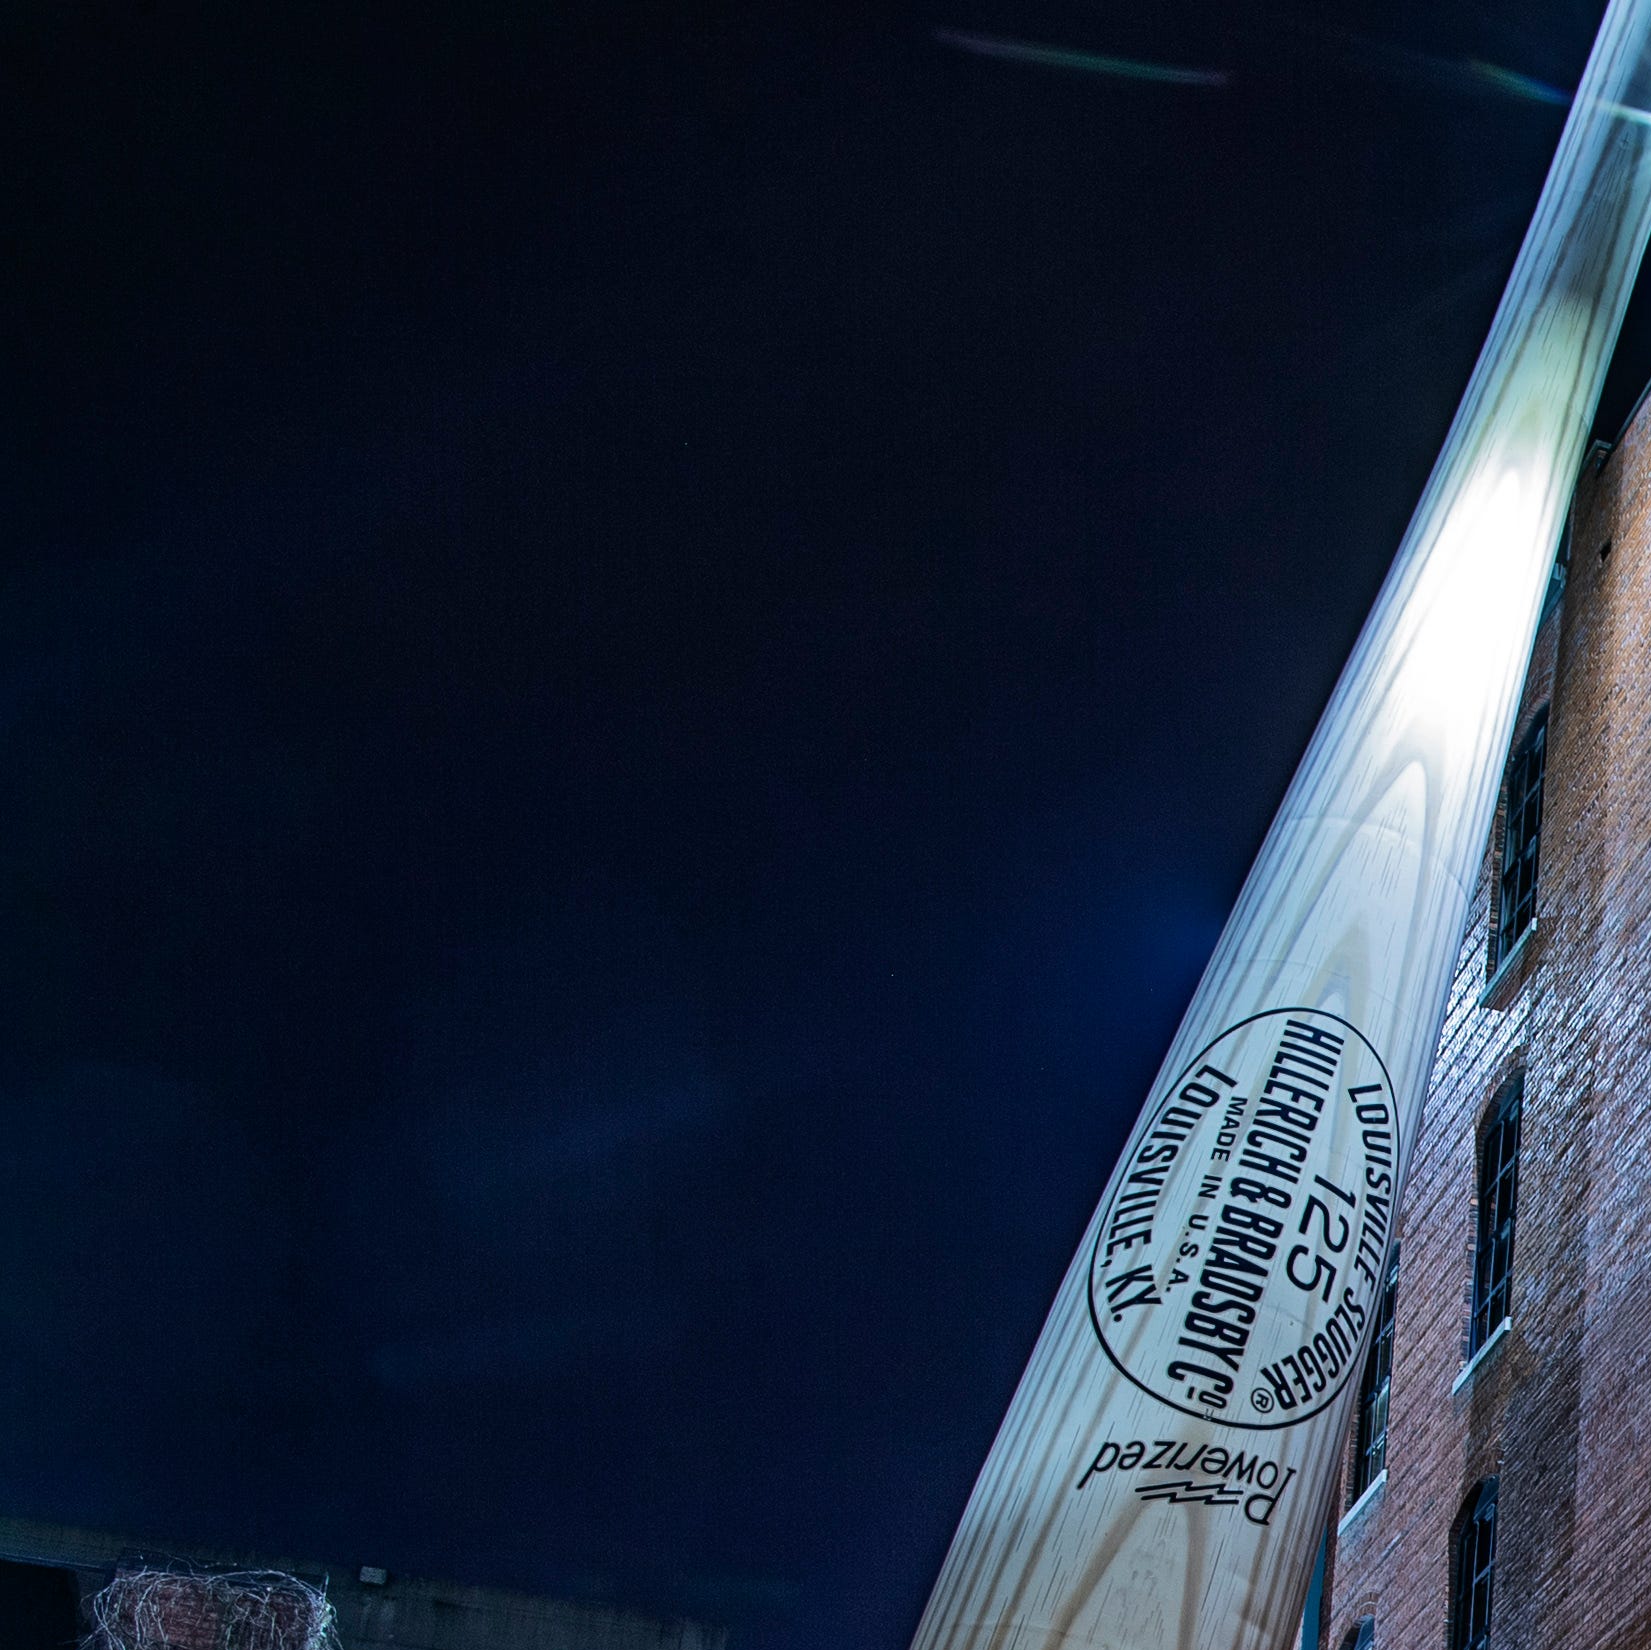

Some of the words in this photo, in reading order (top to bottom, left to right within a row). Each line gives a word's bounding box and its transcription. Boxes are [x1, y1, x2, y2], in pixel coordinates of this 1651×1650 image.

[1210, 1096, 1248, 1162] MADE
[1238, 1019, 1345, 1185] HILLERICH
[1100, 1064, 1238, 1268] LOUISVILLE,
[1197, 1174, 1223, 1200] IN
[1229, 1176, 1292, 1210] &
[1346, 1083, 1392, 1294] LOUISVILLE
[1177, 1204, 1285, 1373] BRADSBY
[1285, 1174, 1357, 1304] 125
[1105, 1264, 1163, 1323] KY.
[1076, 1440, 1310, 1527] Powerized
